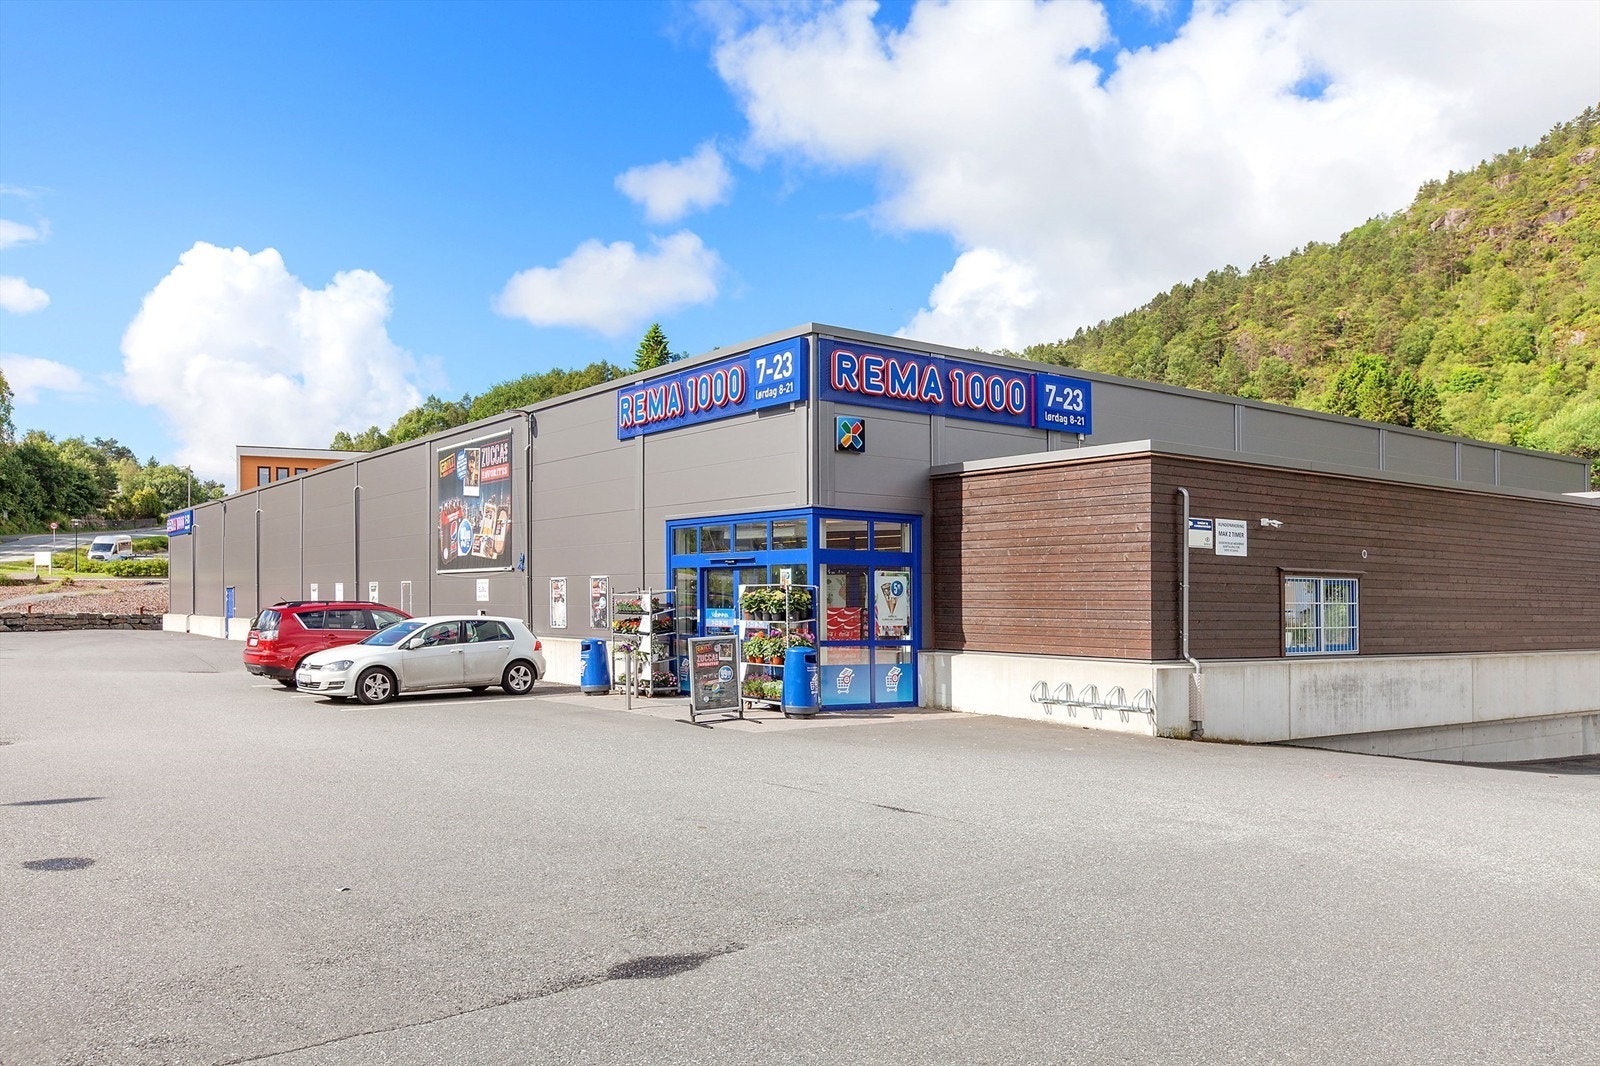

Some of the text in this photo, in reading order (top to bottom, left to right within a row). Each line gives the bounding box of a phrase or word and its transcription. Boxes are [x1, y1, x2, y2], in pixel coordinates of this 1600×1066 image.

[756, 351, 793, 384] 7-23
[831, 349, 1026, 416] REMA 1000
[620, 365, 745, 429] REMA 1000
[755, 381, 794, 400] lørdag 8-21
[1045, 384, 1083, 412] 7-23
[1044, 411, 1085, 426] lørdag 8-21
